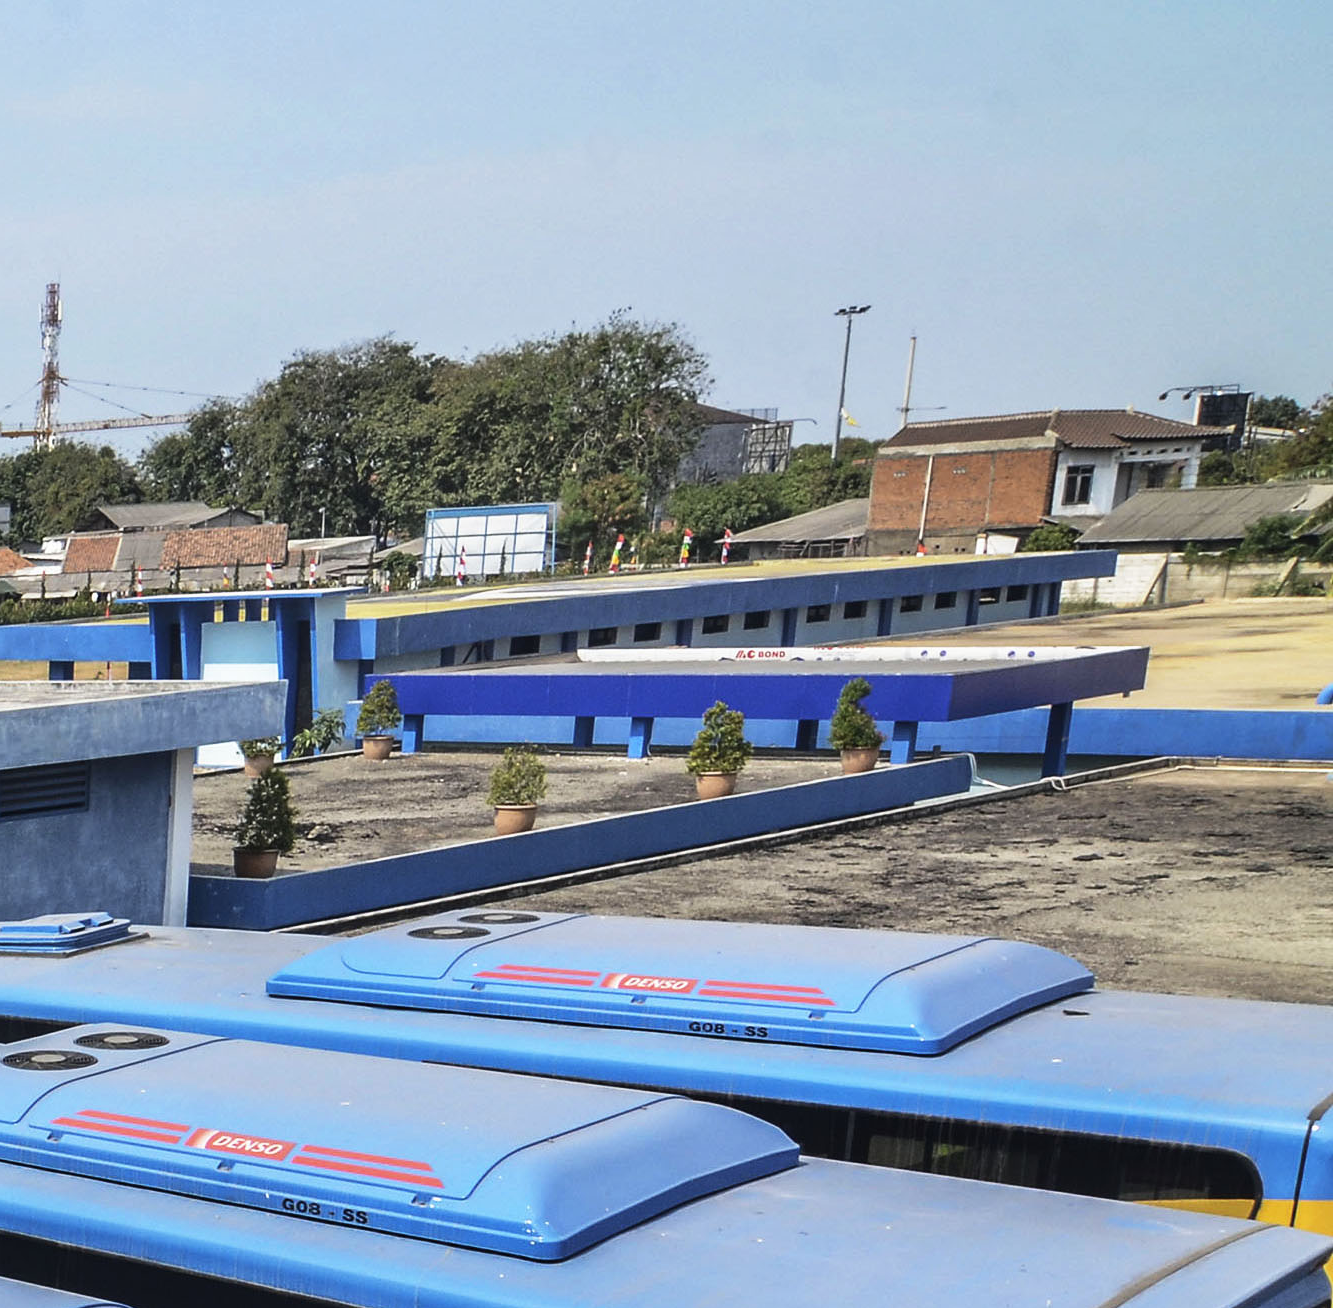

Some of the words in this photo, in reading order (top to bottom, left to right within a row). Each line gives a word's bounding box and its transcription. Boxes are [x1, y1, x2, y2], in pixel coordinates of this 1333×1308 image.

[758, 651, 786, 659] BOND
[624, 977, 689, 990] DENSO
[689, 1021, 725, 1034] G08
[744, 1025, 768, 1038] SS
[212, 1135, 283, 1155] DENSO
[282, 1198, 321, 1216] G08
[342, 1208, 368, 1225] SS
